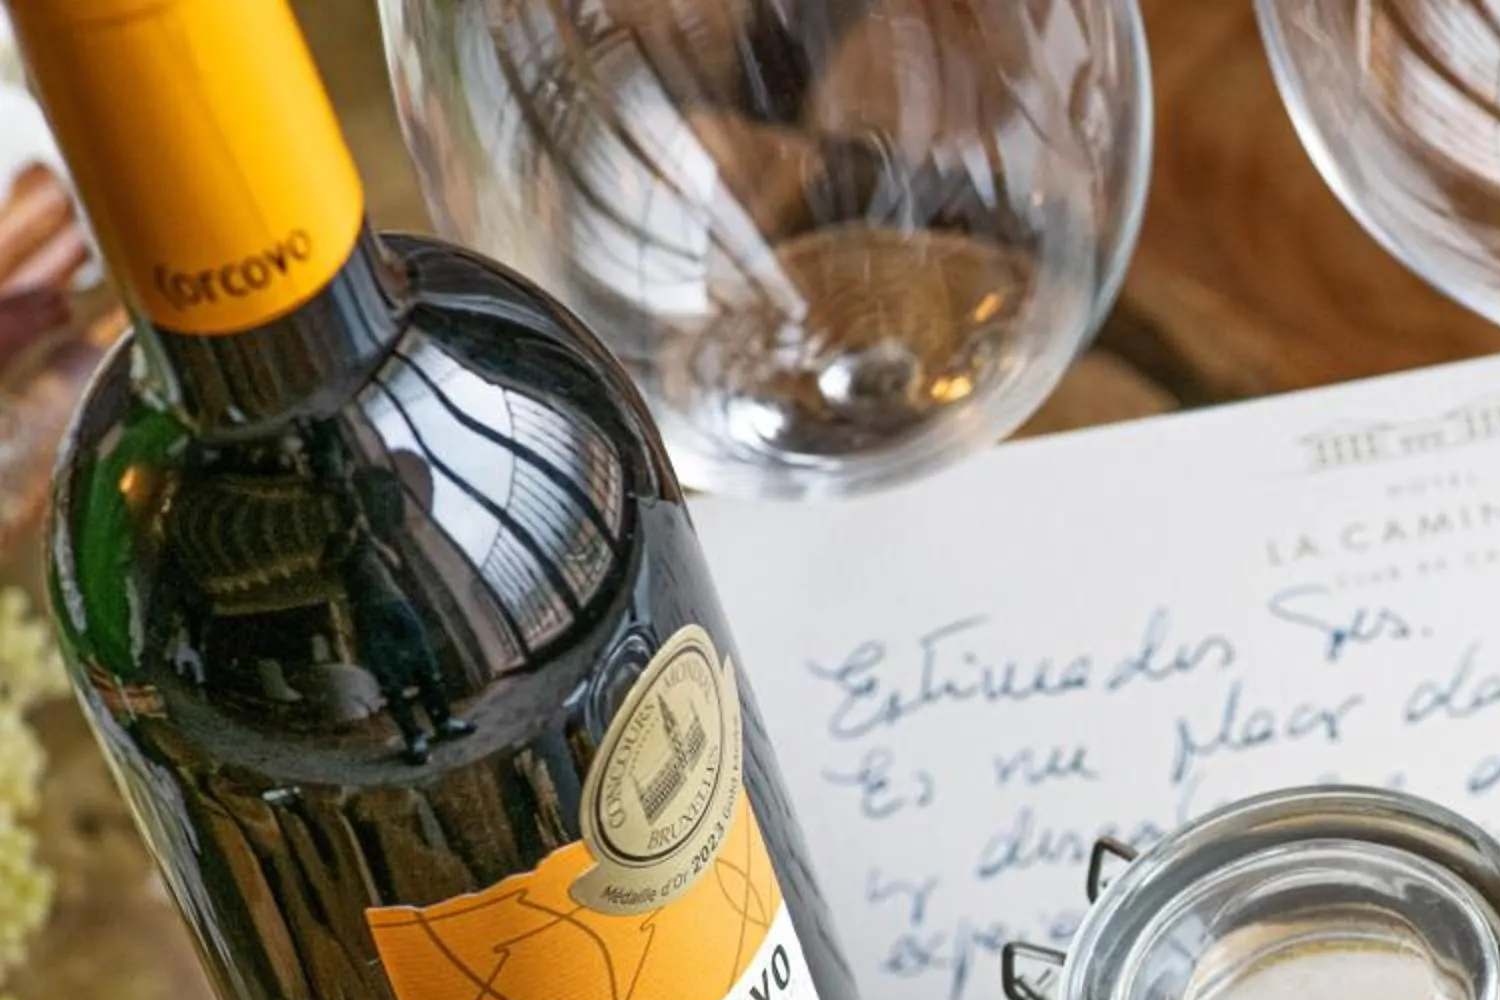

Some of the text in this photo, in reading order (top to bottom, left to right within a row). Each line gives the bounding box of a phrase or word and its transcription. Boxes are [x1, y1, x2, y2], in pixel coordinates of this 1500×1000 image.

[1263, 534, 1321, 567] LA
[808, 604, 1234, 740] Estimados
[824, 748, 934, 819] Es
[1170, 680, 1366, 786] placer
[691, 821, 727, 875] 2023
